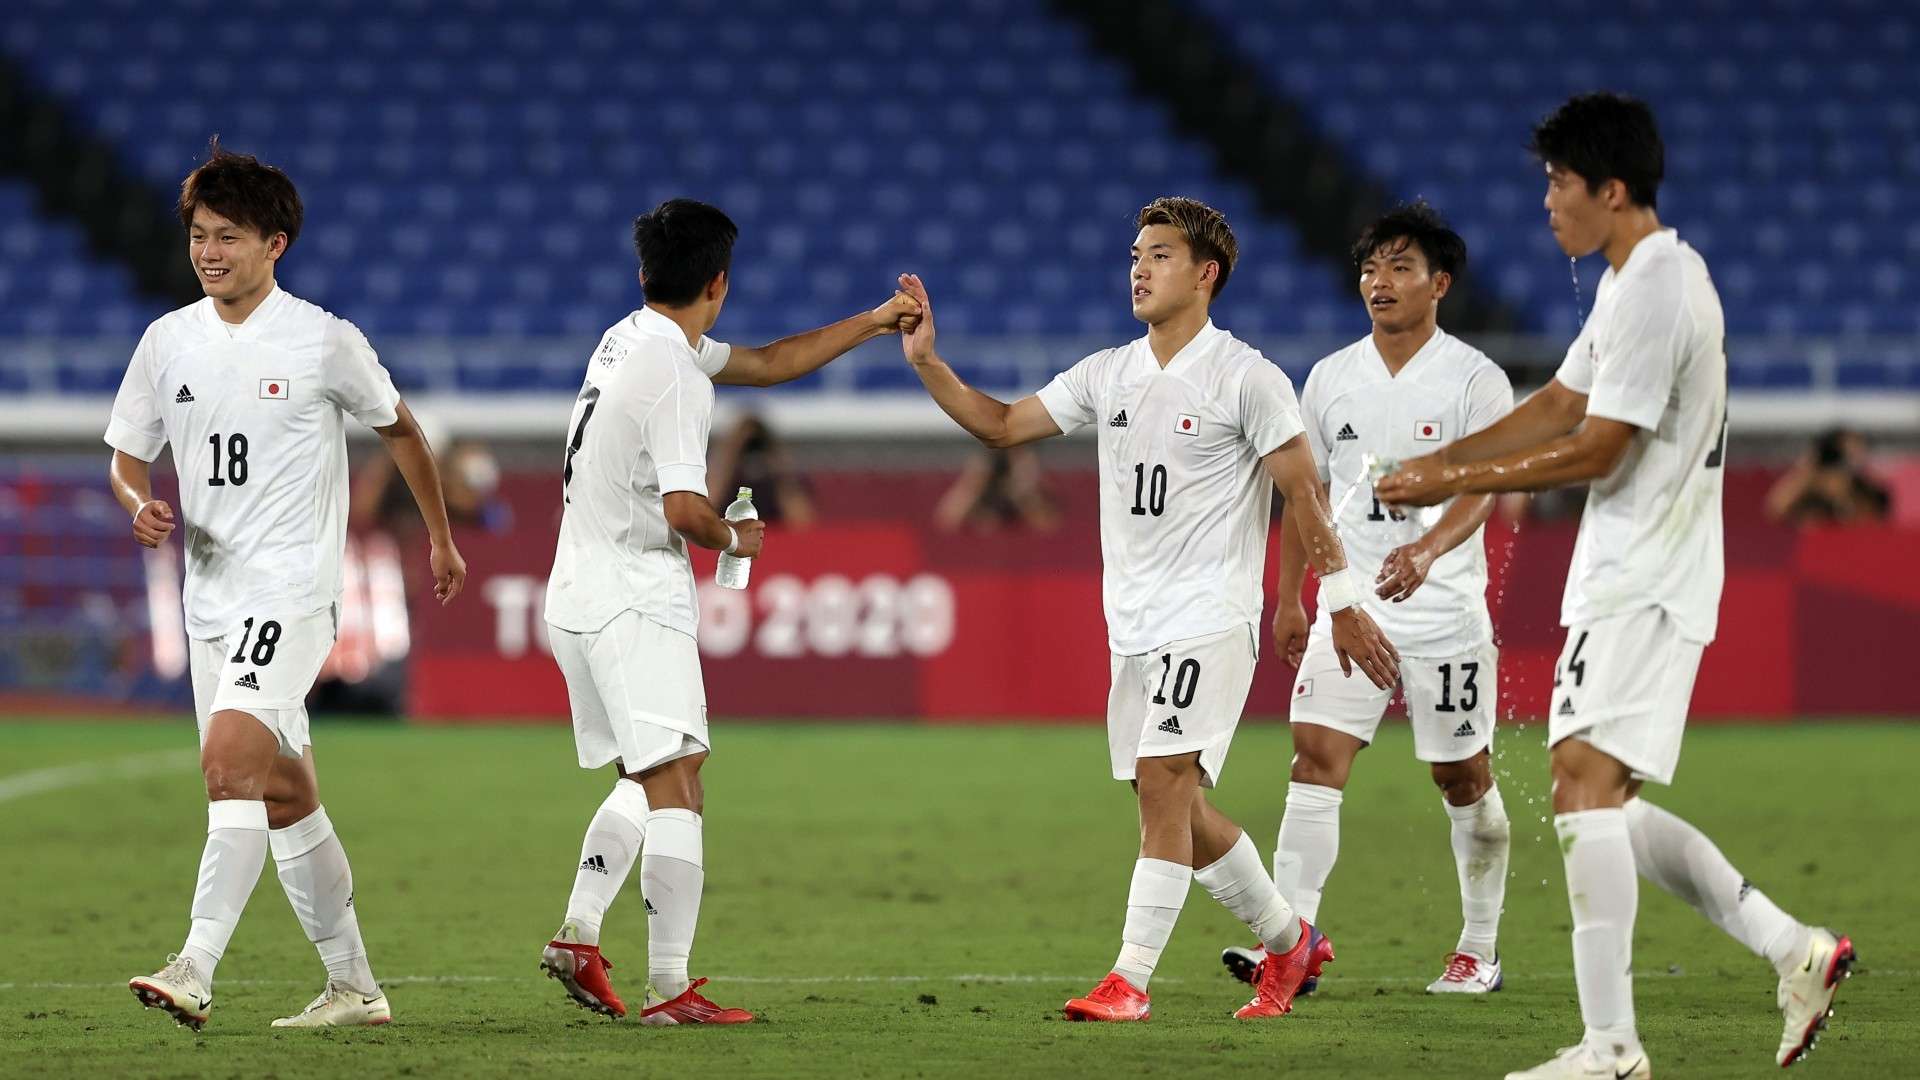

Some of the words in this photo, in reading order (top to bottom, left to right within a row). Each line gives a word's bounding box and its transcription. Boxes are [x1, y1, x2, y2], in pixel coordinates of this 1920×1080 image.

[208, 433, 249, 487] 18
[1131, 463, 1167, 516] 10
[757, 574, 954, 656] 2020
[231, 617, 282, 666] 18
[234, 680, 260, 691] adidas
[1152, 653, 1201, 709] 10
[1435, 662, 1478, 712] 13
[1158, 725, 1183, 735] adidas
